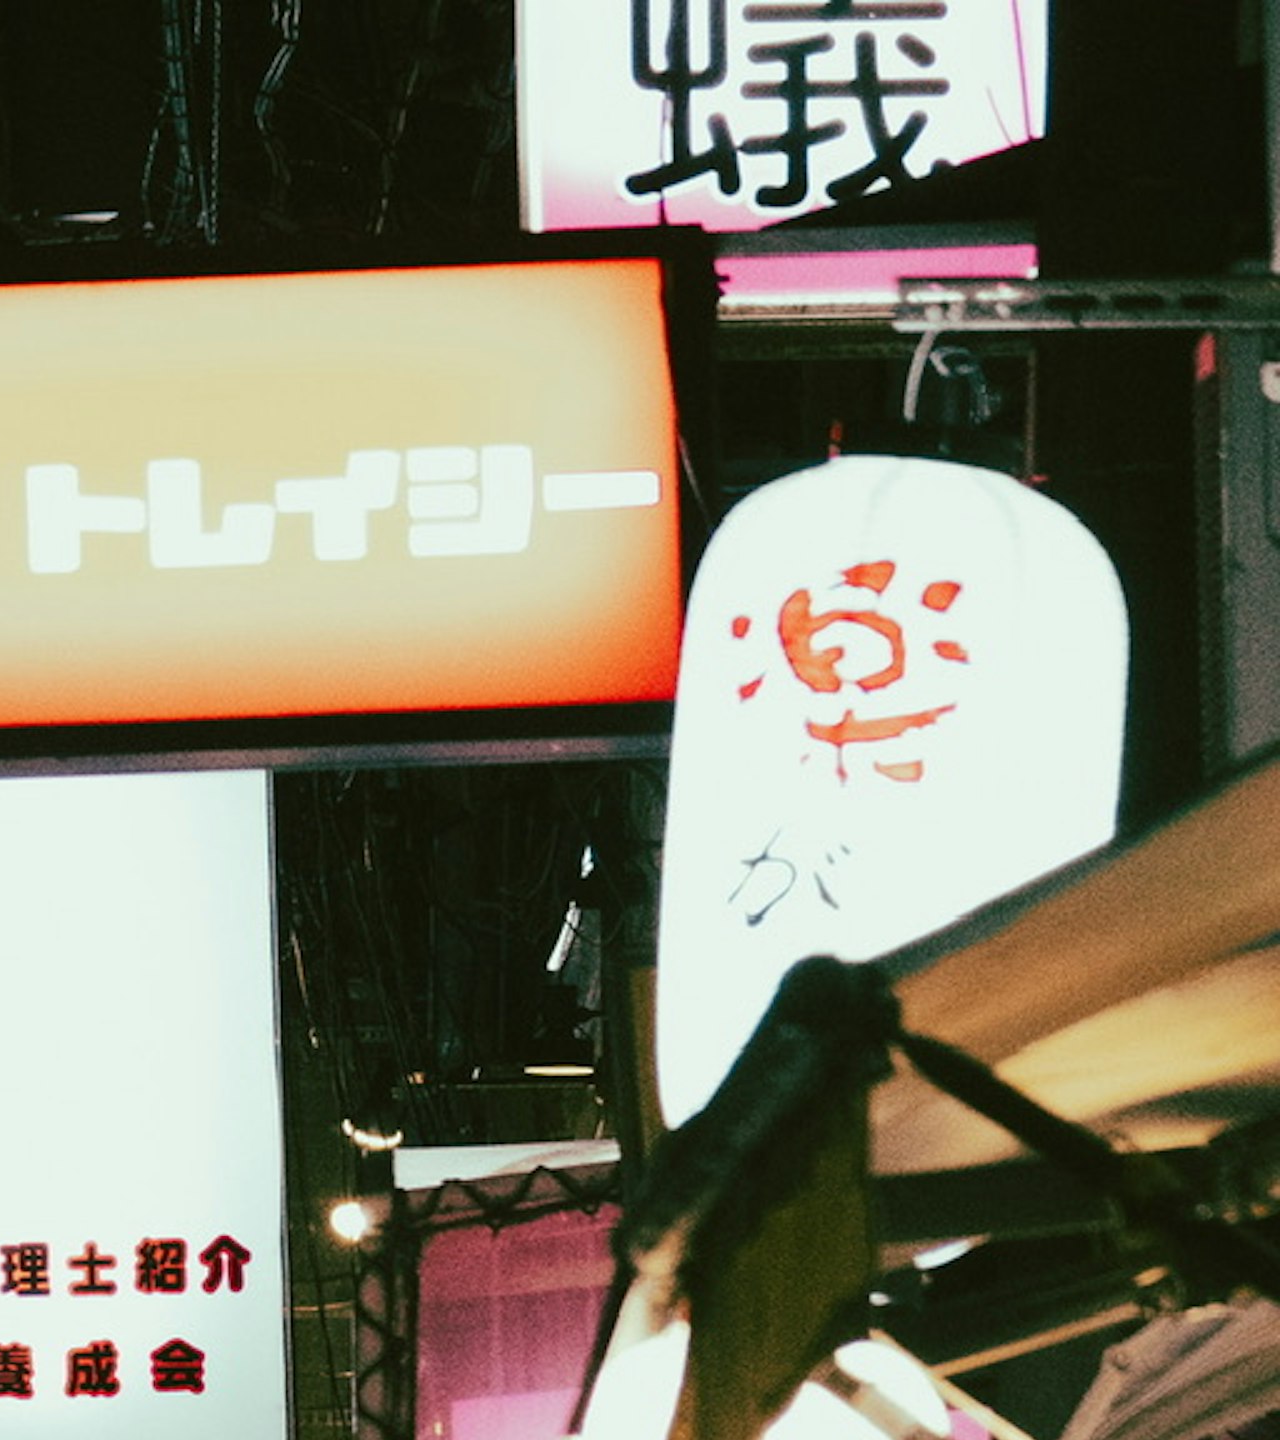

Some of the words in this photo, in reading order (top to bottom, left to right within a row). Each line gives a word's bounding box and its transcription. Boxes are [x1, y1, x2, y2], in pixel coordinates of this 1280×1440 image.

[24, 443, 661, 574] トレイシー
